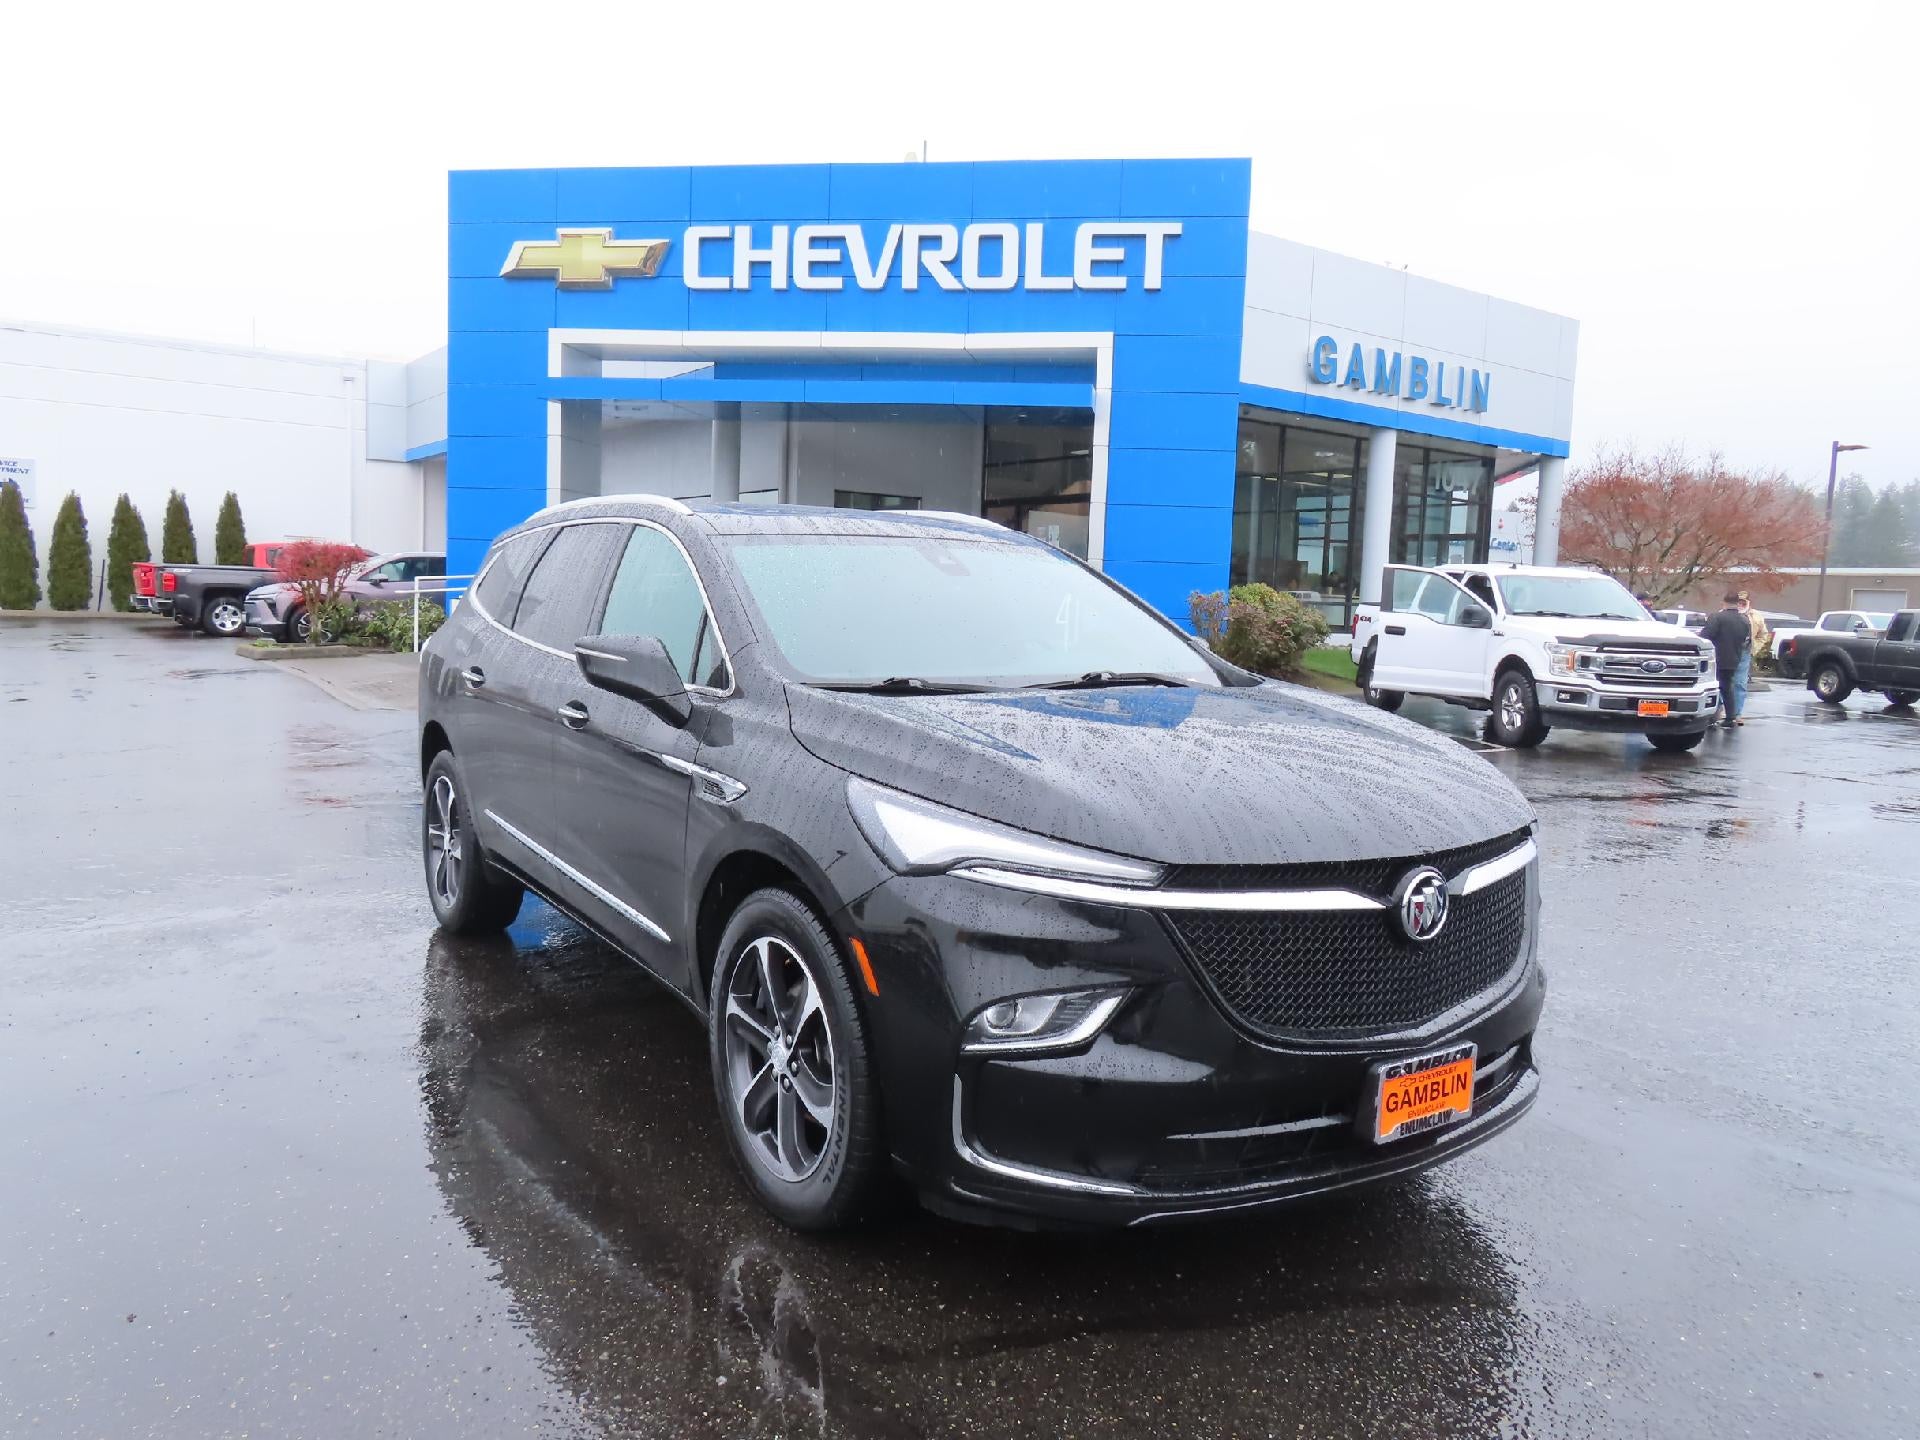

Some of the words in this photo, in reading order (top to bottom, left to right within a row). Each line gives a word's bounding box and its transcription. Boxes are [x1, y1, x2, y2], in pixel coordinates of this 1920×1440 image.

[683, 221, 1183, 291] CHEVROLET
[1310, 335, 1490, 413] GAMBLIN
[1385, 1048, 1473, 1079] GAMBLIN
[1418, 1066, 1458, 1083] CHEVROLET
[1385, 1072, 1468, 1113] GAMBLIN
[1399, 1108, 1455, 1136] ENUMCLAW
